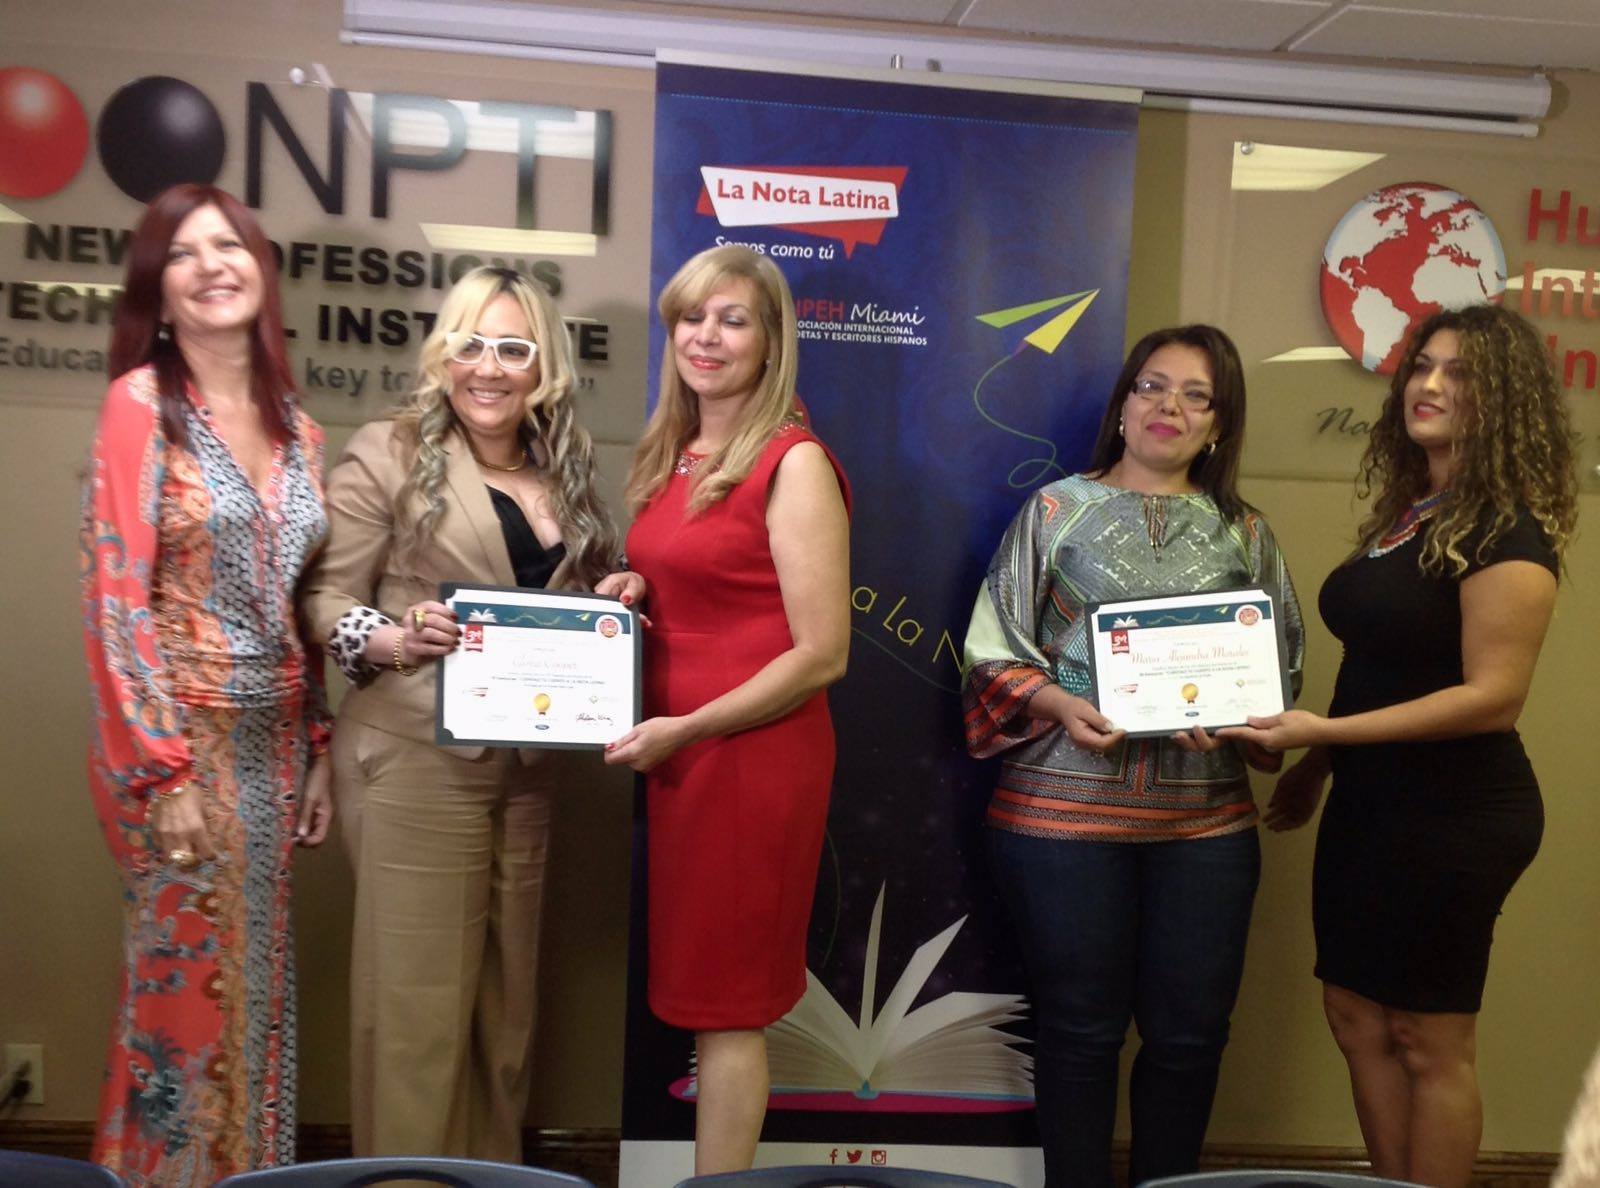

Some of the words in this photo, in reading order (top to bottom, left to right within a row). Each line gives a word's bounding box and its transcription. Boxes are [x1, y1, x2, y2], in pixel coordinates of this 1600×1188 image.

[246, 81, 613, 236] NPTI
[717, 178, 744, 200] La
[752, 181, 811, 205] Nota
[818, 186, 890, 211] Latina
[770, 244, 813, 259] como
[818, 244, 835, 260] tú
[850, 302, 926, 325] Miami
[797, 320, 842, 331] OCIACIÓN
[844, 323, 914, 336] INTERNACIONAL
[824, 331, 830, 340] Y
[832, 332, 882, 344] ESCRITORES
[884, 335, 927, 346] HISPANOS
[306, 357, 368, 397] key
[882, 596, 924, 646] La
